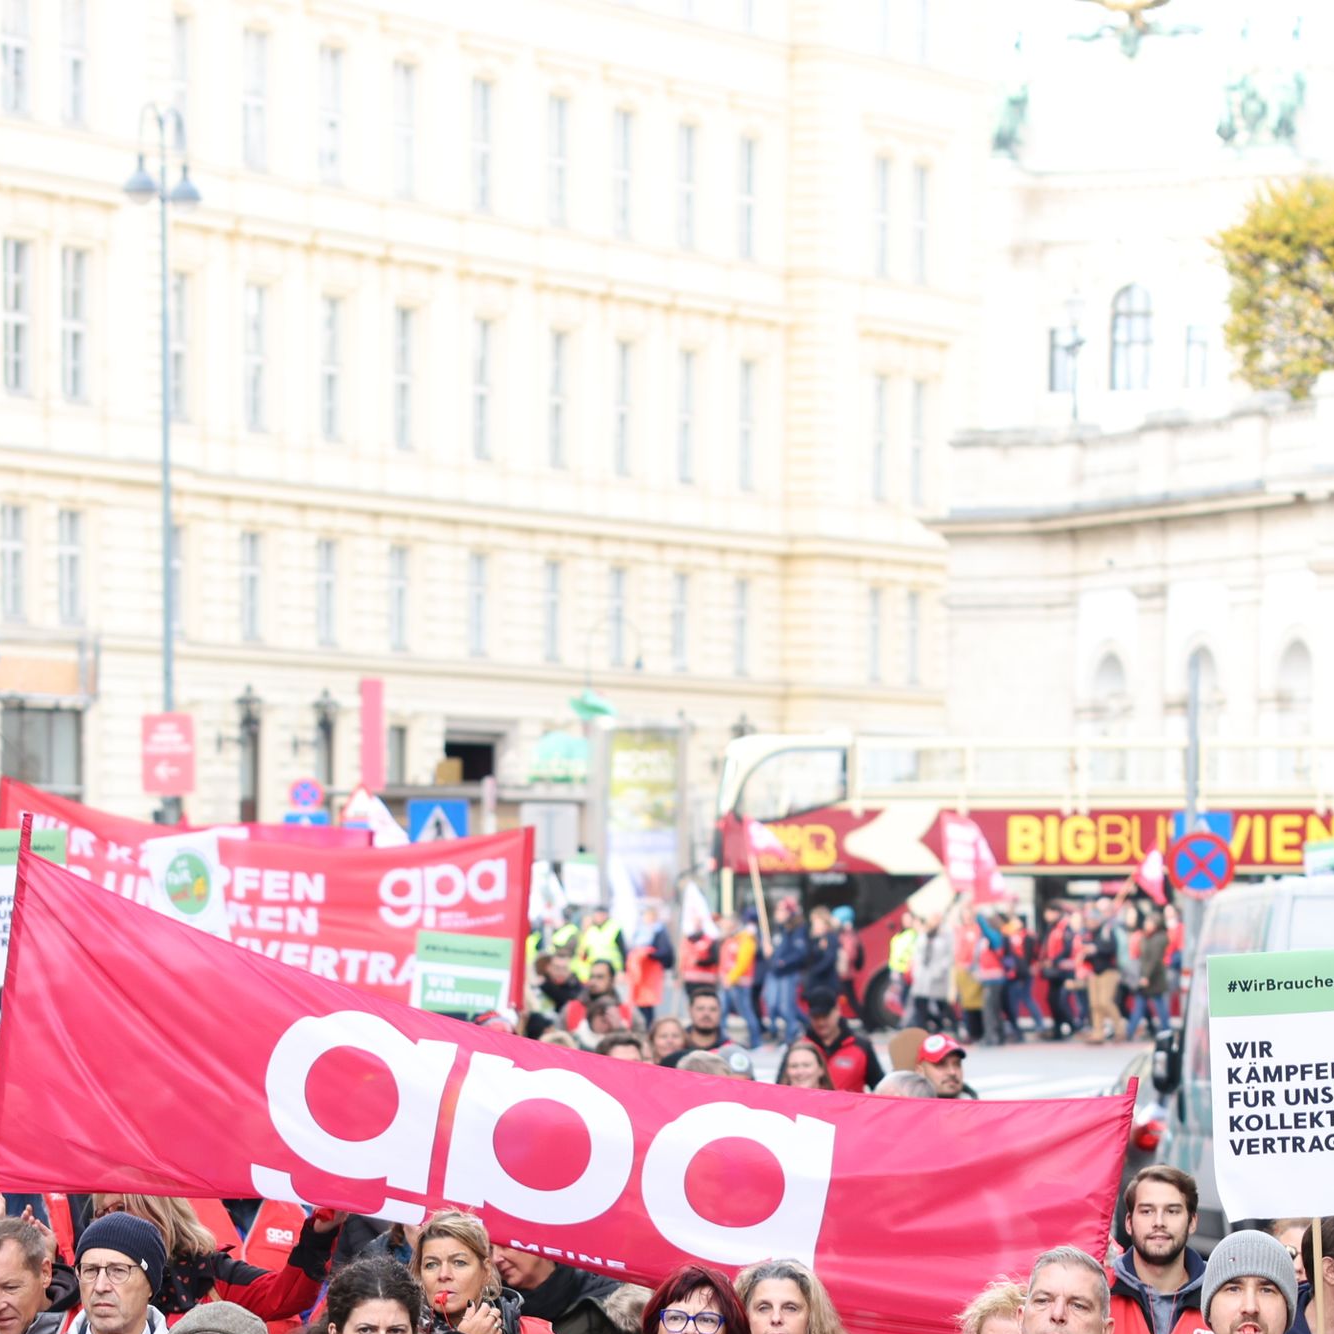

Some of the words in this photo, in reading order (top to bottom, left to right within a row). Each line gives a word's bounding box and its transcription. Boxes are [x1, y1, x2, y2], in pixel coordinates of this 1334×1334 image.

[1007, 814, 1174, 864] BIGBU
[378, 857, 508, 928] gpa
[1226, 1040, 1274, 1060] WIR
[1228, 1086, 1277, 1109] FÜR
[250, 1009, 837, 1269] gpa
[266, 1226, 294, 1243] gpa
[510, 1239, 627, 1271] MEINE
